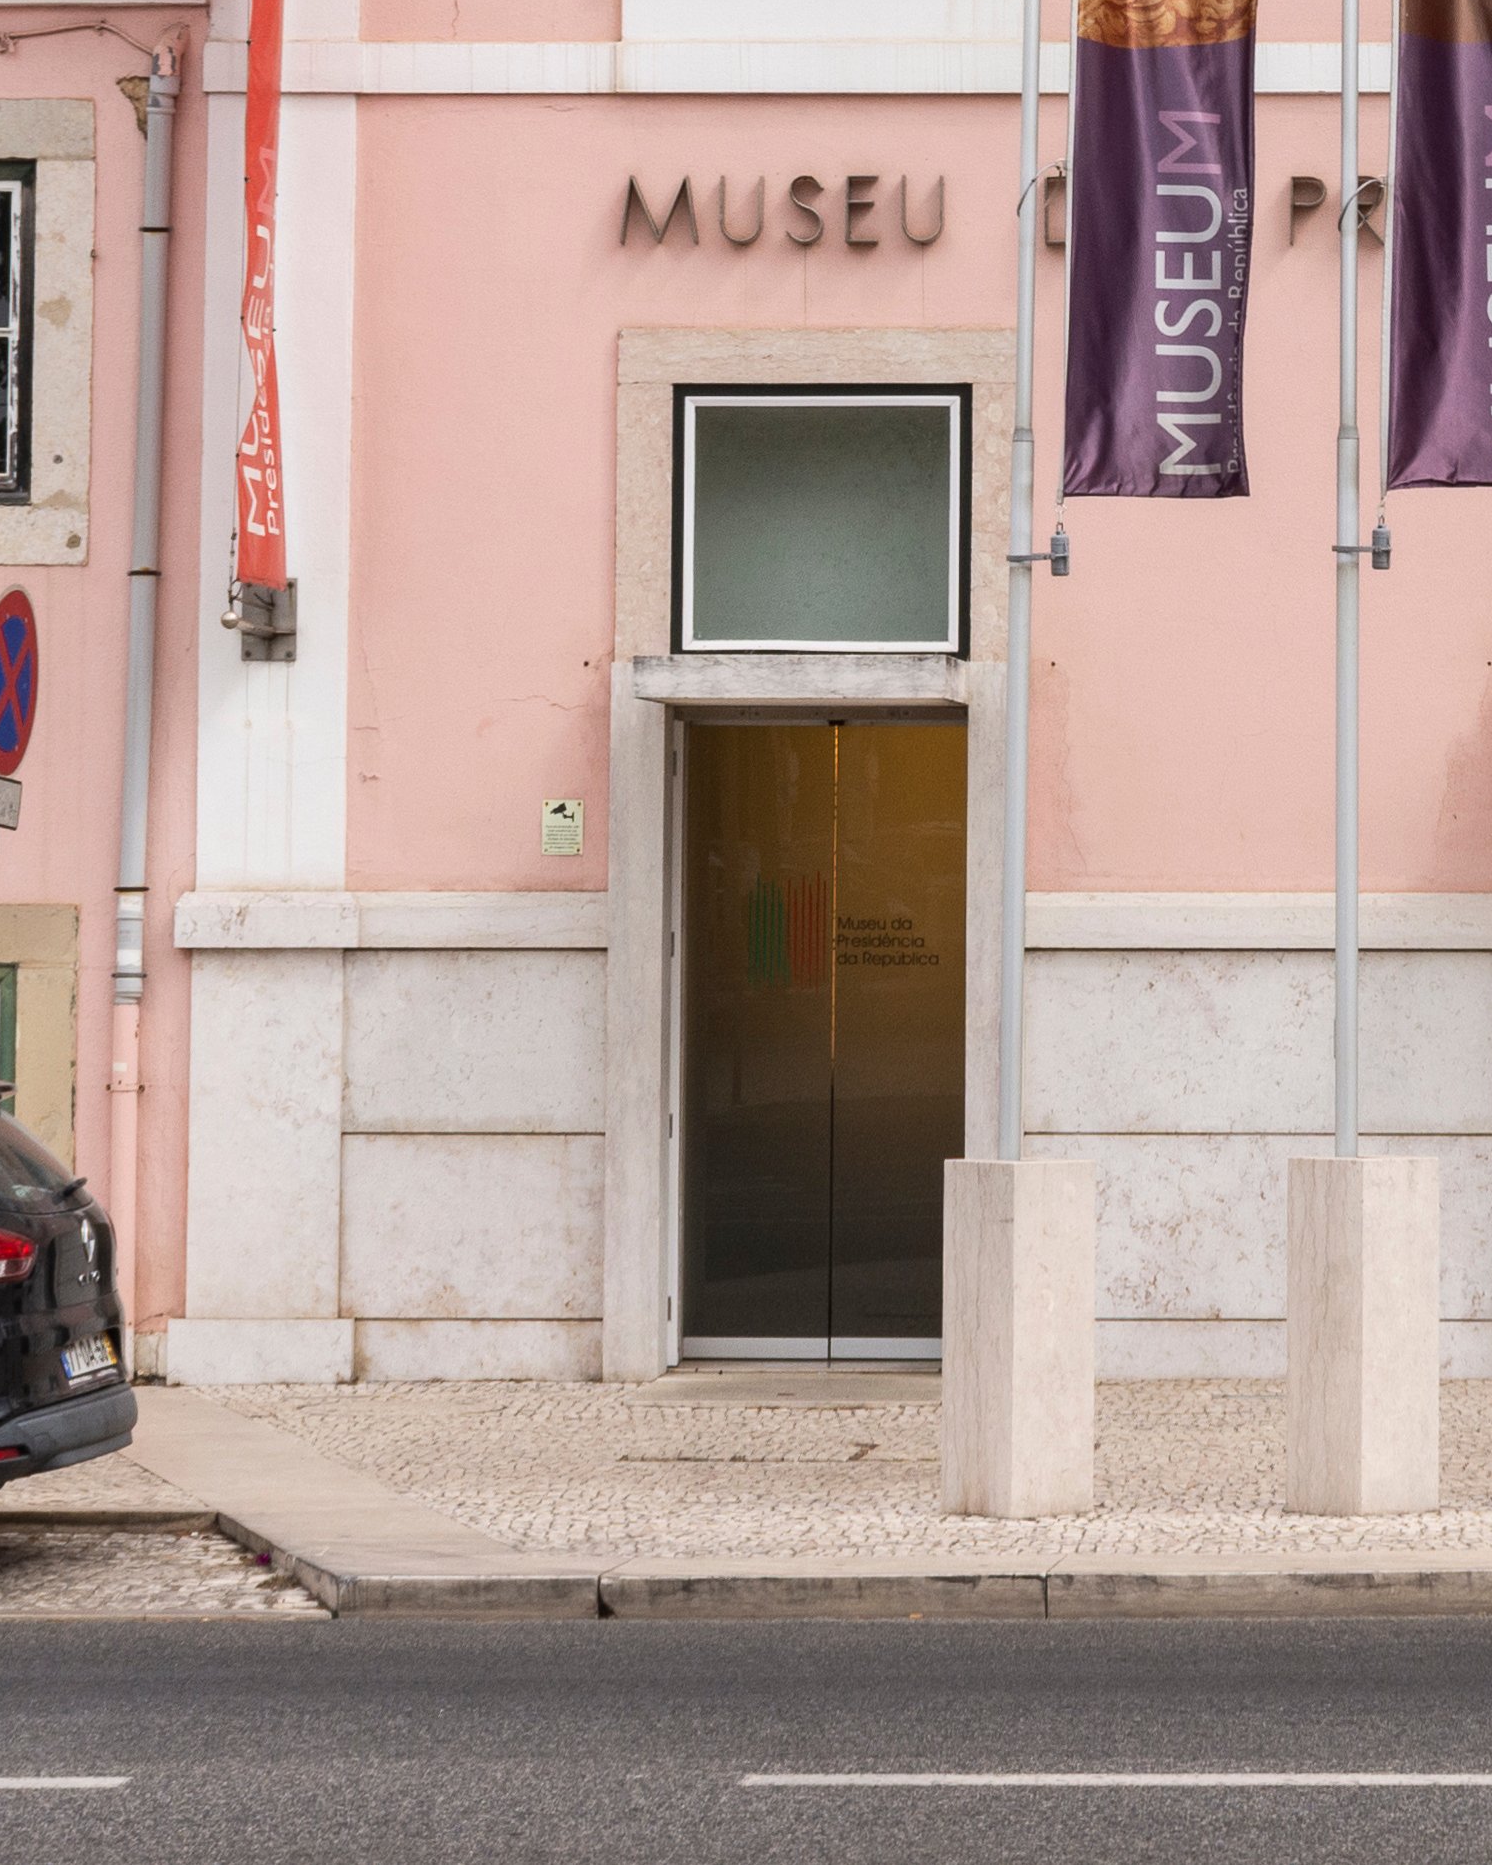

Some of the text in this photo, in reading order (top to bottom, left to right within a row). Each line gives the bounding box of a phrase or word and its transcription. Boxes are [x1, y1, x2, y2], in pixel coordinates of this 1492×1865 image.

[620, 174, 946, 247] MUSEU
[1154, 110, 1223, 476] MUSEUM
[837, 917, 913, 931] Museu da
[837, 933, 925, 948] Presidência
[837, 951, 940, 968] da República
